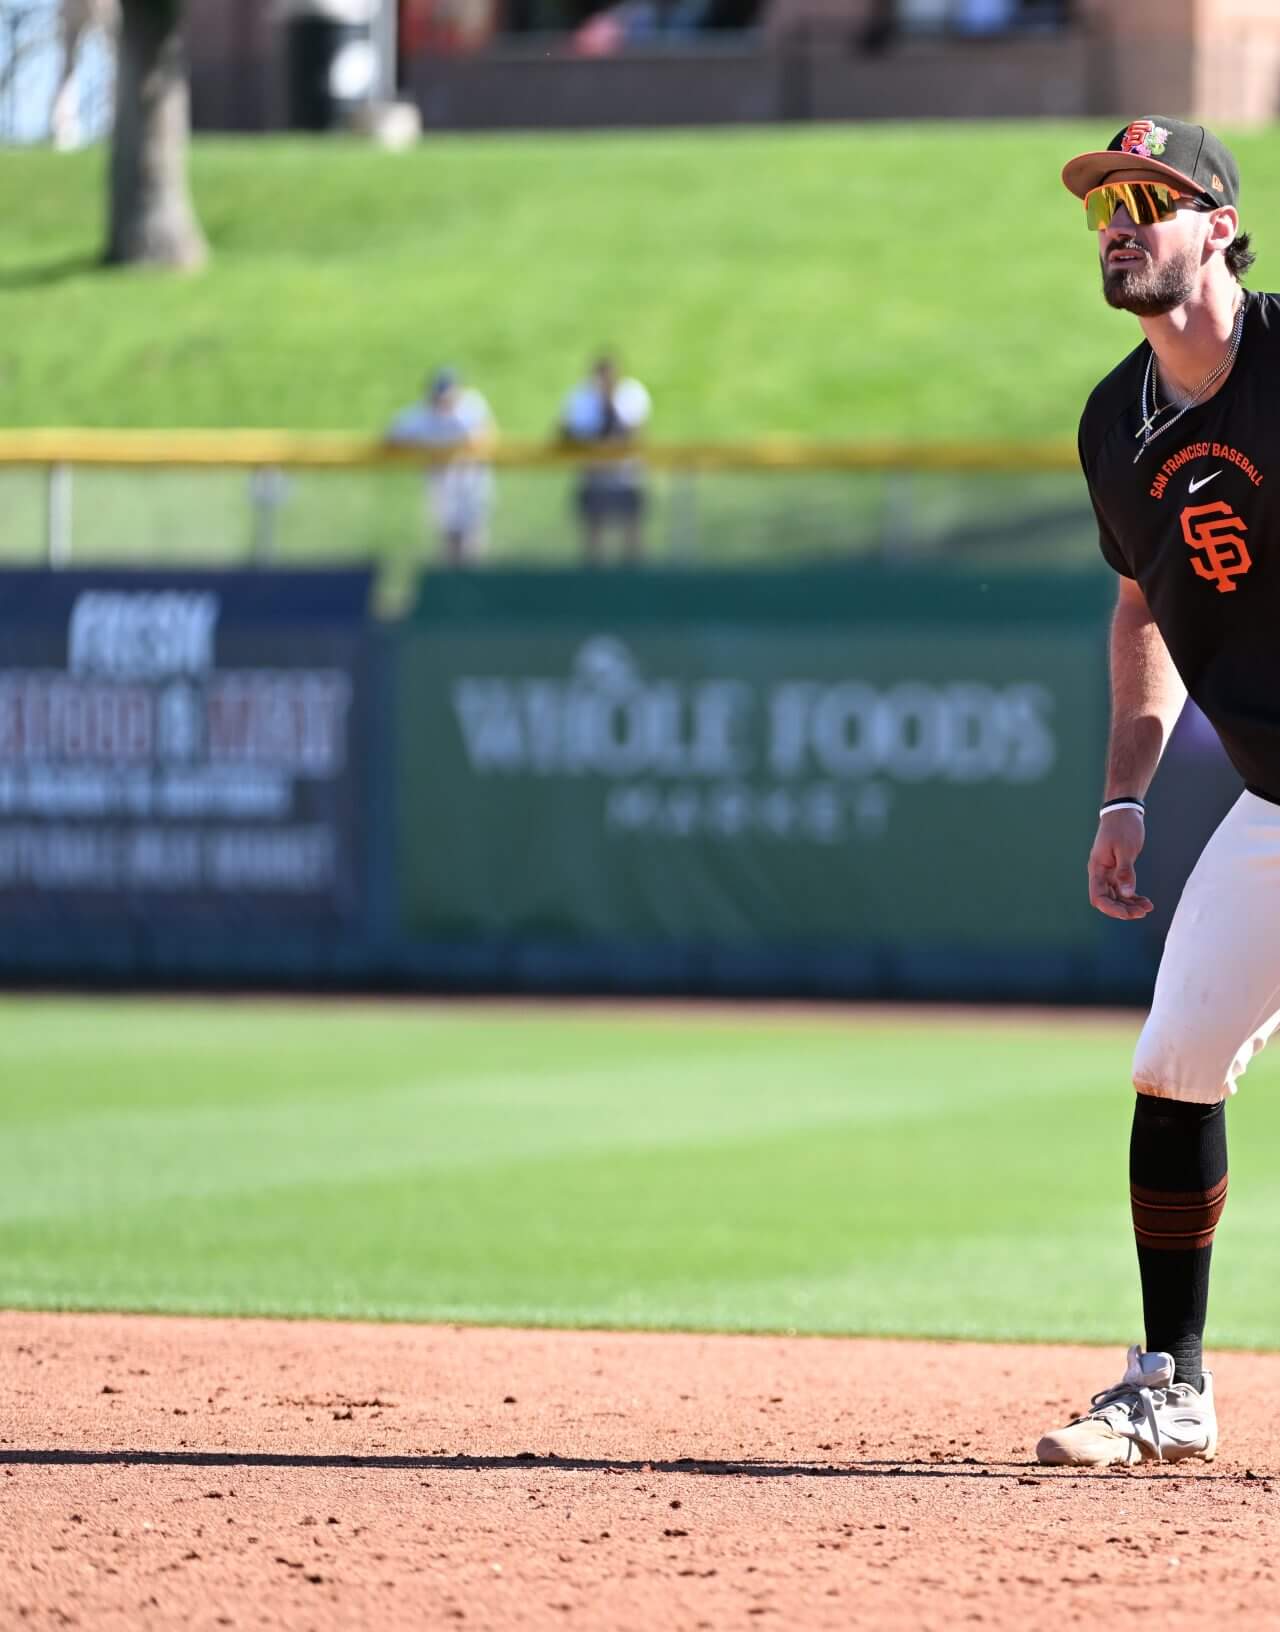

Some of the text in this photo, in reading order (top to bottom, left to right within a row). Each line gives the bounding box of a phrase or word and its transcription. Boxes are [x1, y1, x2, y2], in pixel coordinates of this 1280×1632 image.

[1150, 472, 1169, 499] SAN
[1212, 442, 1265, 487] BASEBALL
[1179, 500, 1252, 593] SF
[454, 677, 1055, 783] WHOLE FOODS
[608, 781, 891, 842] MARKET
